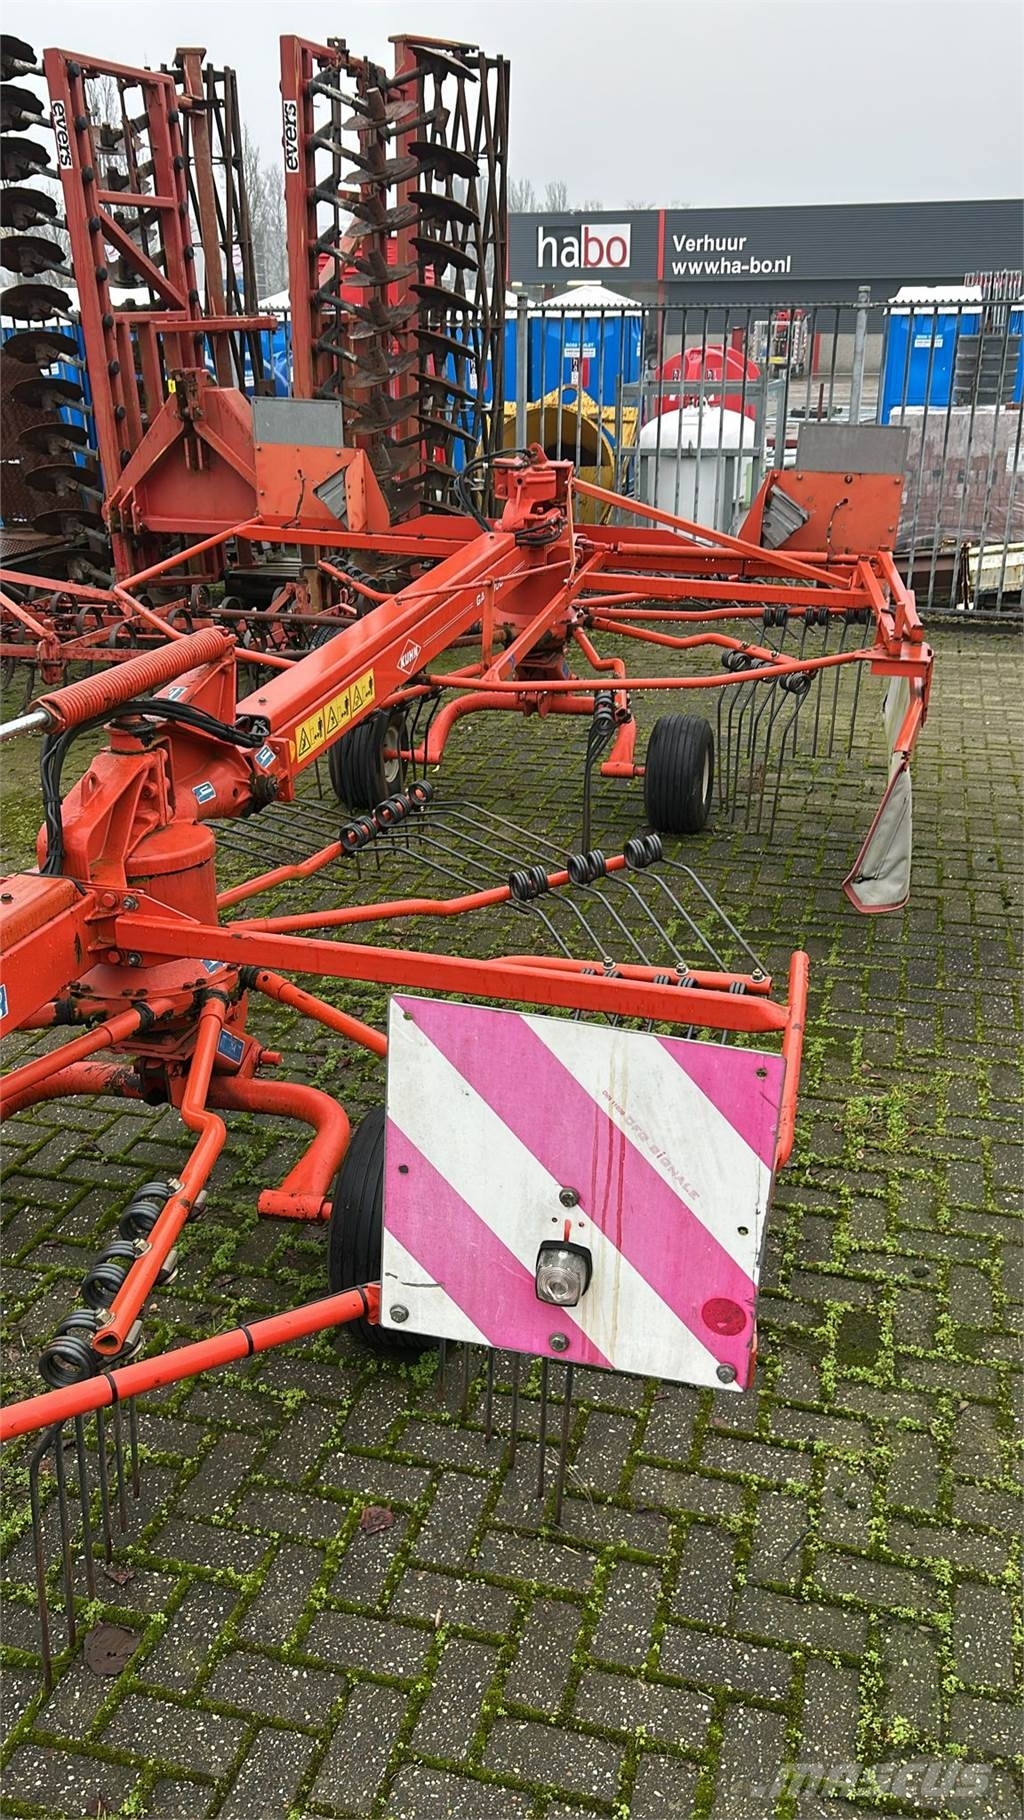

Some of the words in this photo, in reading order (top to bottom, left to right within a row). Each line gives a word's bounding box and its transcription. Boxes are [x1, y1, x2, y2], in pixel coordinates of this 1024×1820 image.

[53, 102, 72, 166] evers
[284, 103, 299, 170] evers
[537, 226, 627, 268] habo
[672, 234, 747, 252] Verhuur
[671, 255, 791, 275] www.ha-bo.nl
[400, 646, 419, 669] KUHN
